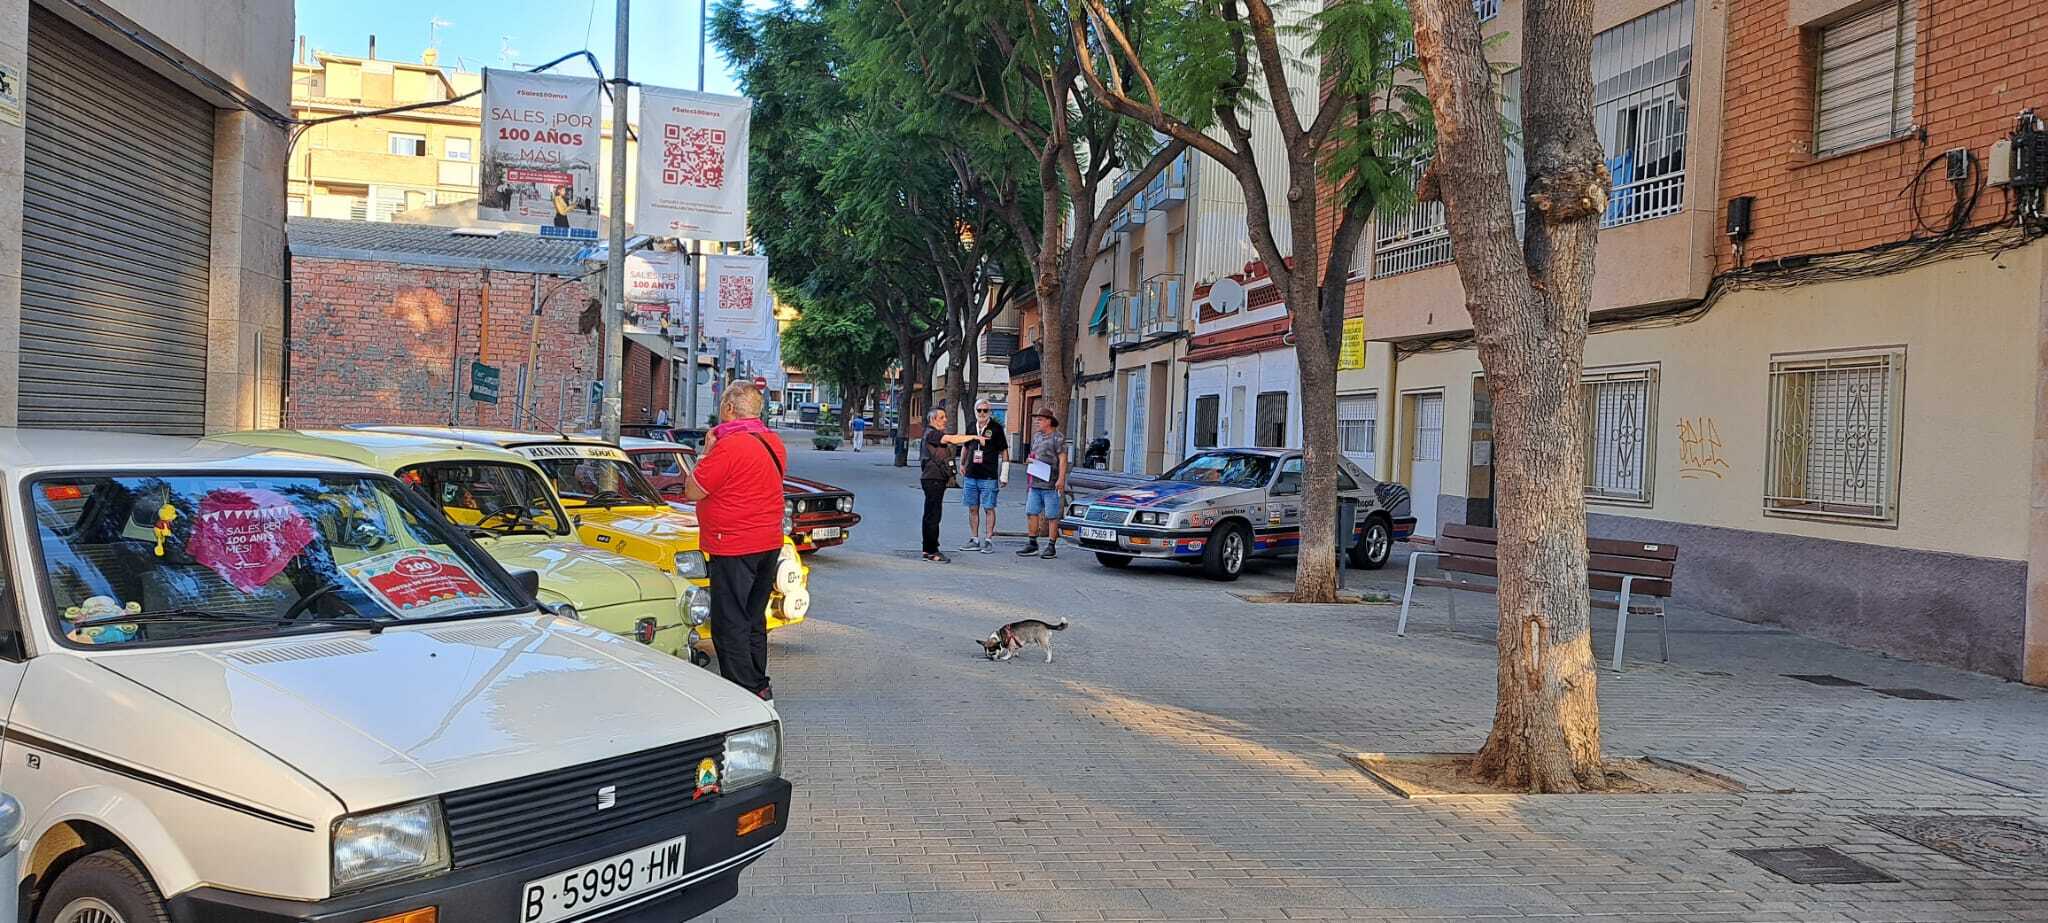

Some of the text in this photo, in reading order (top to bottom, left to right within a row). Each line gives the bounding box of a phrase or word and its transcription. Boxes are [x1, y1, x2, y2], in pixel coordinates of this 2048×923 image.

[491, 107, 593, 129] SALES, ¡POR
[498, 127, 583, 146] 100 AÑOS
[520, 146, 561, 163] MÁS!
[632, 280, 676, 290] 100 ANYS
[528, 446, 579, 457] RENAULT
[225, 535, 247, 545] 100
[405, 561, 433, 573] 100
